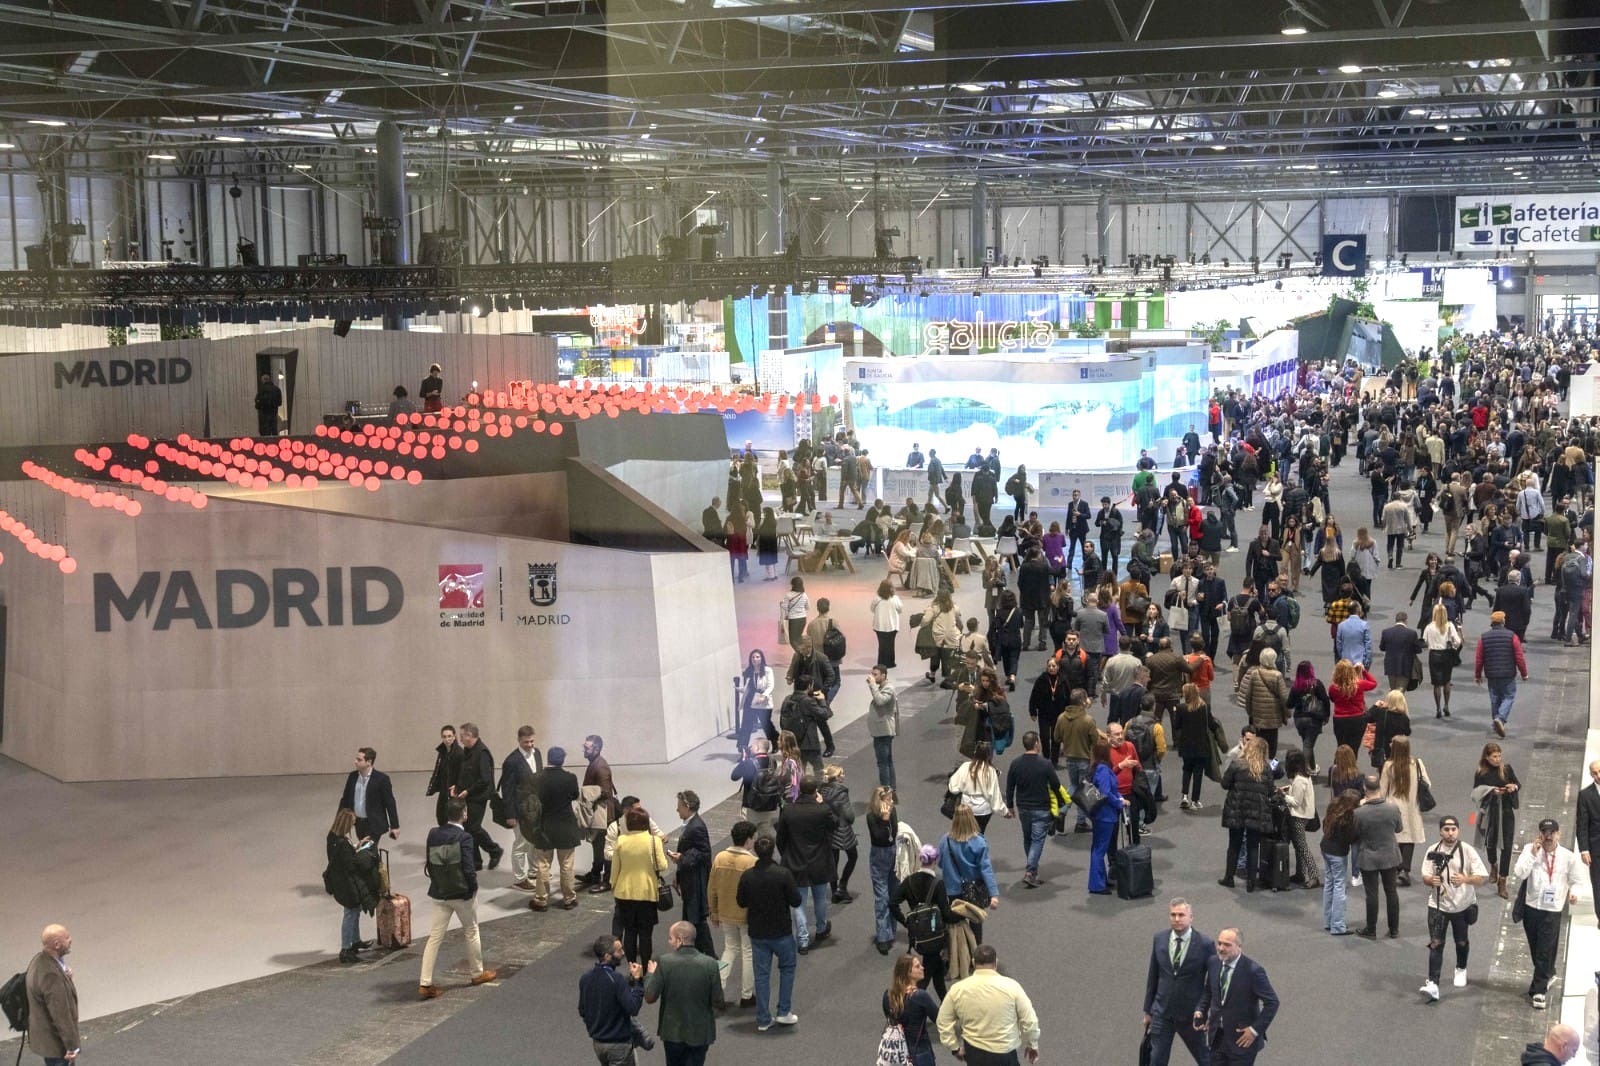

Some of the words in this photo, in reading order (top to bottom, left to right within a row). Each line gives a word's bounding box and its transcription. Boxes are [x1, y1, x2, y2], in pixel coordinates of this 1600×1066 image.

[1514, 202, 1599, 221] afetería
[1518, 225, 1581, 243] Cafete
[1332, 240, 1358, 271] C
[1423, 281, 1442, 293] TERÍA
[921, 310, 1055, 357] galicia
[54, 353, 192, 389] MADRID
[93, 566, 404, 632] MADRID
[440, 611, 485, 619] Cuidad
[454, 619, 485, 627] Madrid
[517, 614, 571, 626] MADRID
